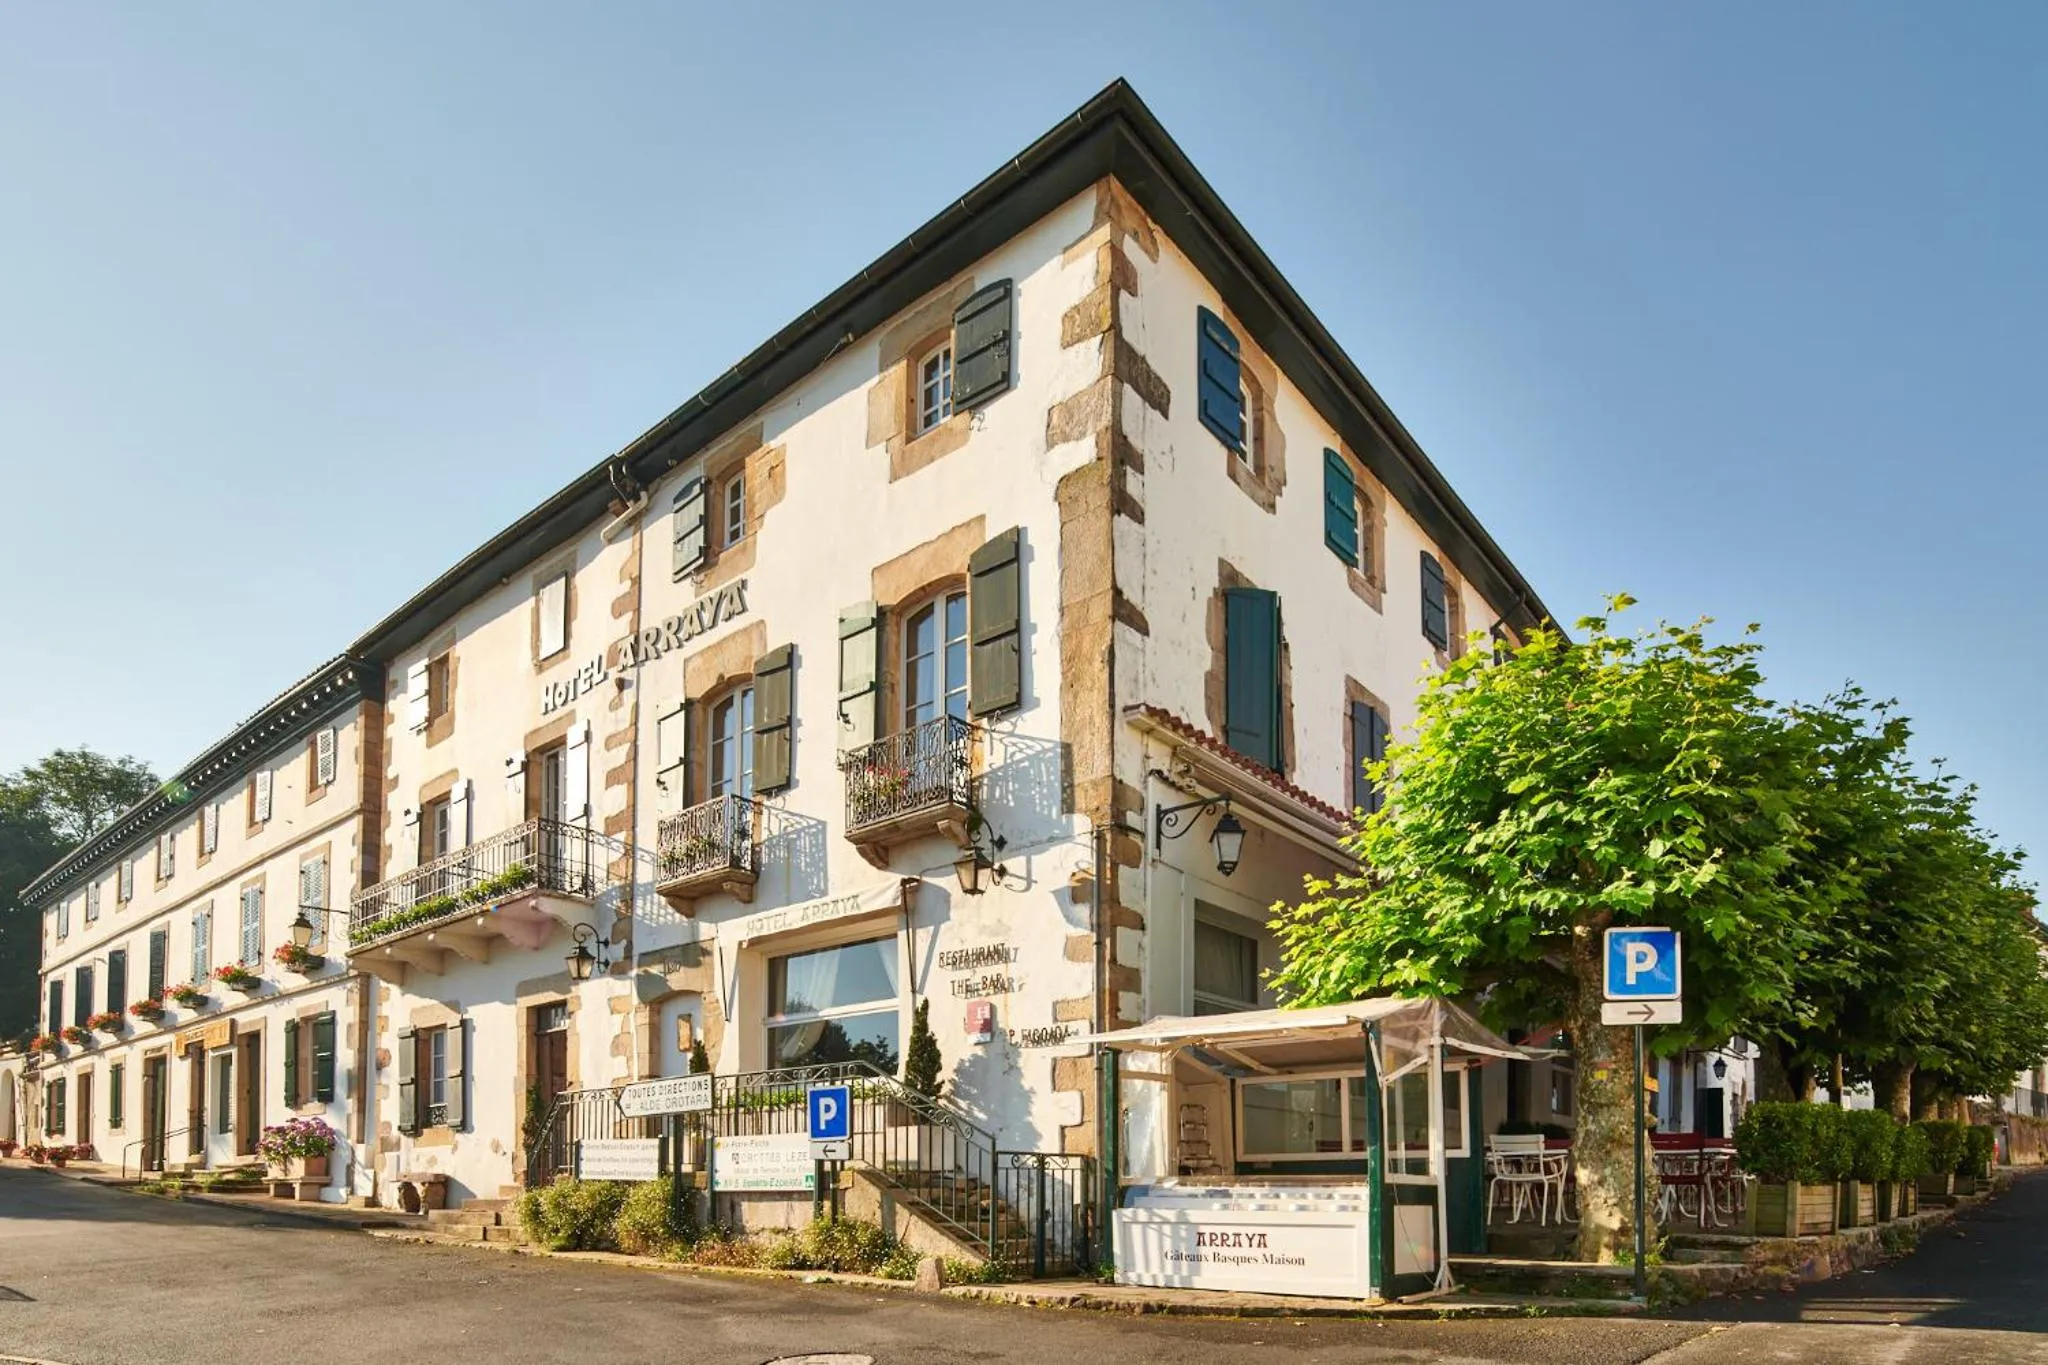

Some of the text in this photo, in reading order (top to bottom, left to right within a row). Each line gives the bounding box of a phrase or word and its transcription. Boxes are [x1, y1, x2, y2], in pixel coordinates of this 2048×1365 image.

[542, 578, 749, 716] HOTEL ARRAYA
[746, 894, 861, 937] HOTEL ARRAYA
[938, 943, 1006, 968] RESTAURANT
[1626, 942, 1658, 985] P
[981, 972, 1003, 991] BAR
[628, 1079, 709, 1099] TOUTES DIRECTIONS
[819, 1097, 838, 1130] P
[1196, 1231, 1268, 1249] ARRAYA
[1164, 1249, 1306, 1267] Gâteaux Basques Maison
